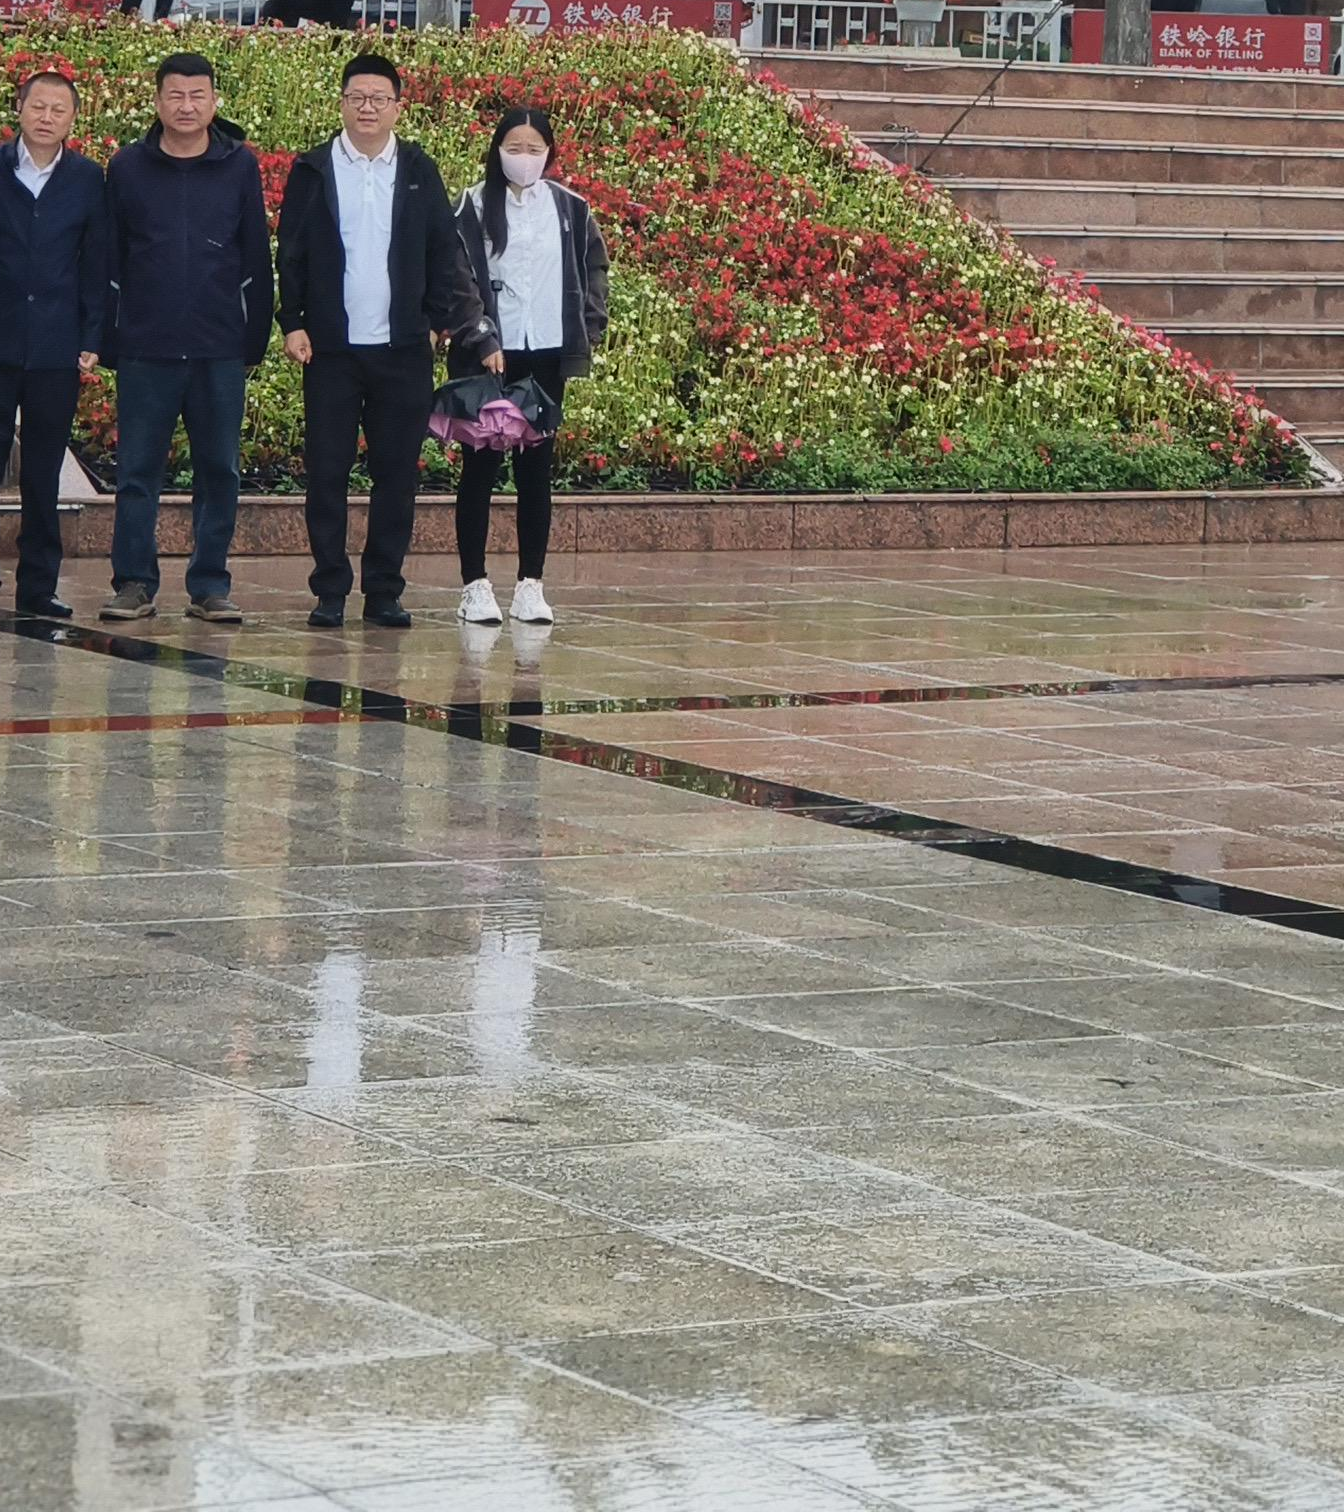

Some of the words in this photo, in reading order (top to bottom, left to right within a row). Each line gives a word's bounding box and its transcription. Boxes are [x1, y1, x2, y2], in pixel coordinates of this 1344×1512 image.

[562, 0, 674, 27] 铁岭银行
[1158, 23, 1266, 49] 铁岭银行
[1159, 48, 1193, 58] BANK
[1196, 49, 1213, 59] OF
[1217, 49, 1264, 60] TIELING
